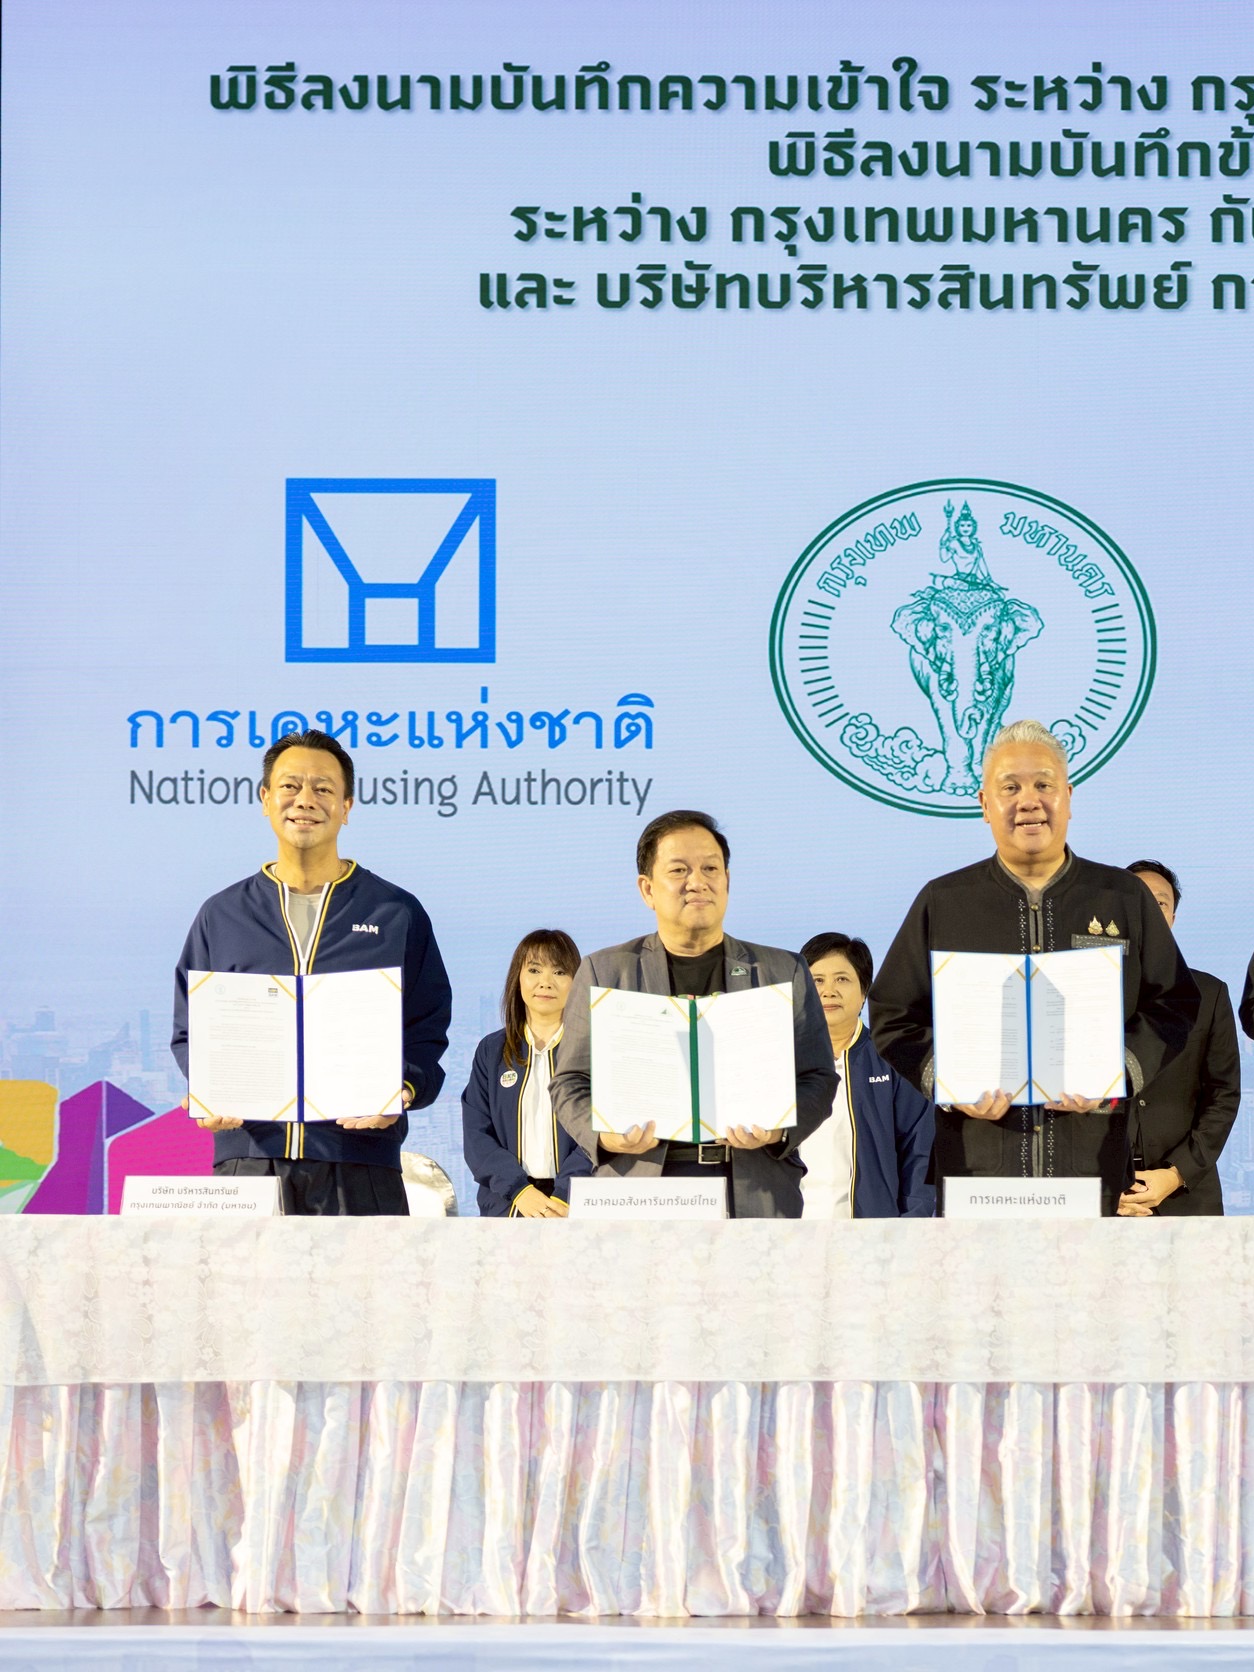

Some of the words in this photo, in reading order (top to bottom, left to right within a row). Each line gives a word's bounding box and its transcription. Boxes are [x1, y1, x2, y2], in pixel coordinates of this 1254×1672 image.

[211, 56, 949, 111] พิธีลงนามบันทึกความเข้าใจ
[971, 62, 1168, 111] ระหว่าง
[511, 192, 707, 241] ระหว่าง
[731, 204, 1189, 255] กรุงเทพมหานคร
[480, 272, 575, 309] และ
[597, 261, 1190, 310] บริษัทบริหารสินทรัพย์
[816, 511, 922, 598] กรุงเทพ
[999, 511, 1116, 600] มหานคร
[127, 686, 655, 750] การเคหะแห่งชาติ
[129, 769, 264, 805] Nation
[356, 769, 459, 818] using
[472, 768, 653, 816] Authority
[351, 923, 379, 935] BAM
[868, 1074, 890, 1083] BAM
[151, 1186, 175, 1196] บริษัท
[583, 1193, 718, 1207] สมาคมอสังหาริมทรัพย์ไทย
[969, 1193, 1067, 1206] การเคหะแห่งชาติ
